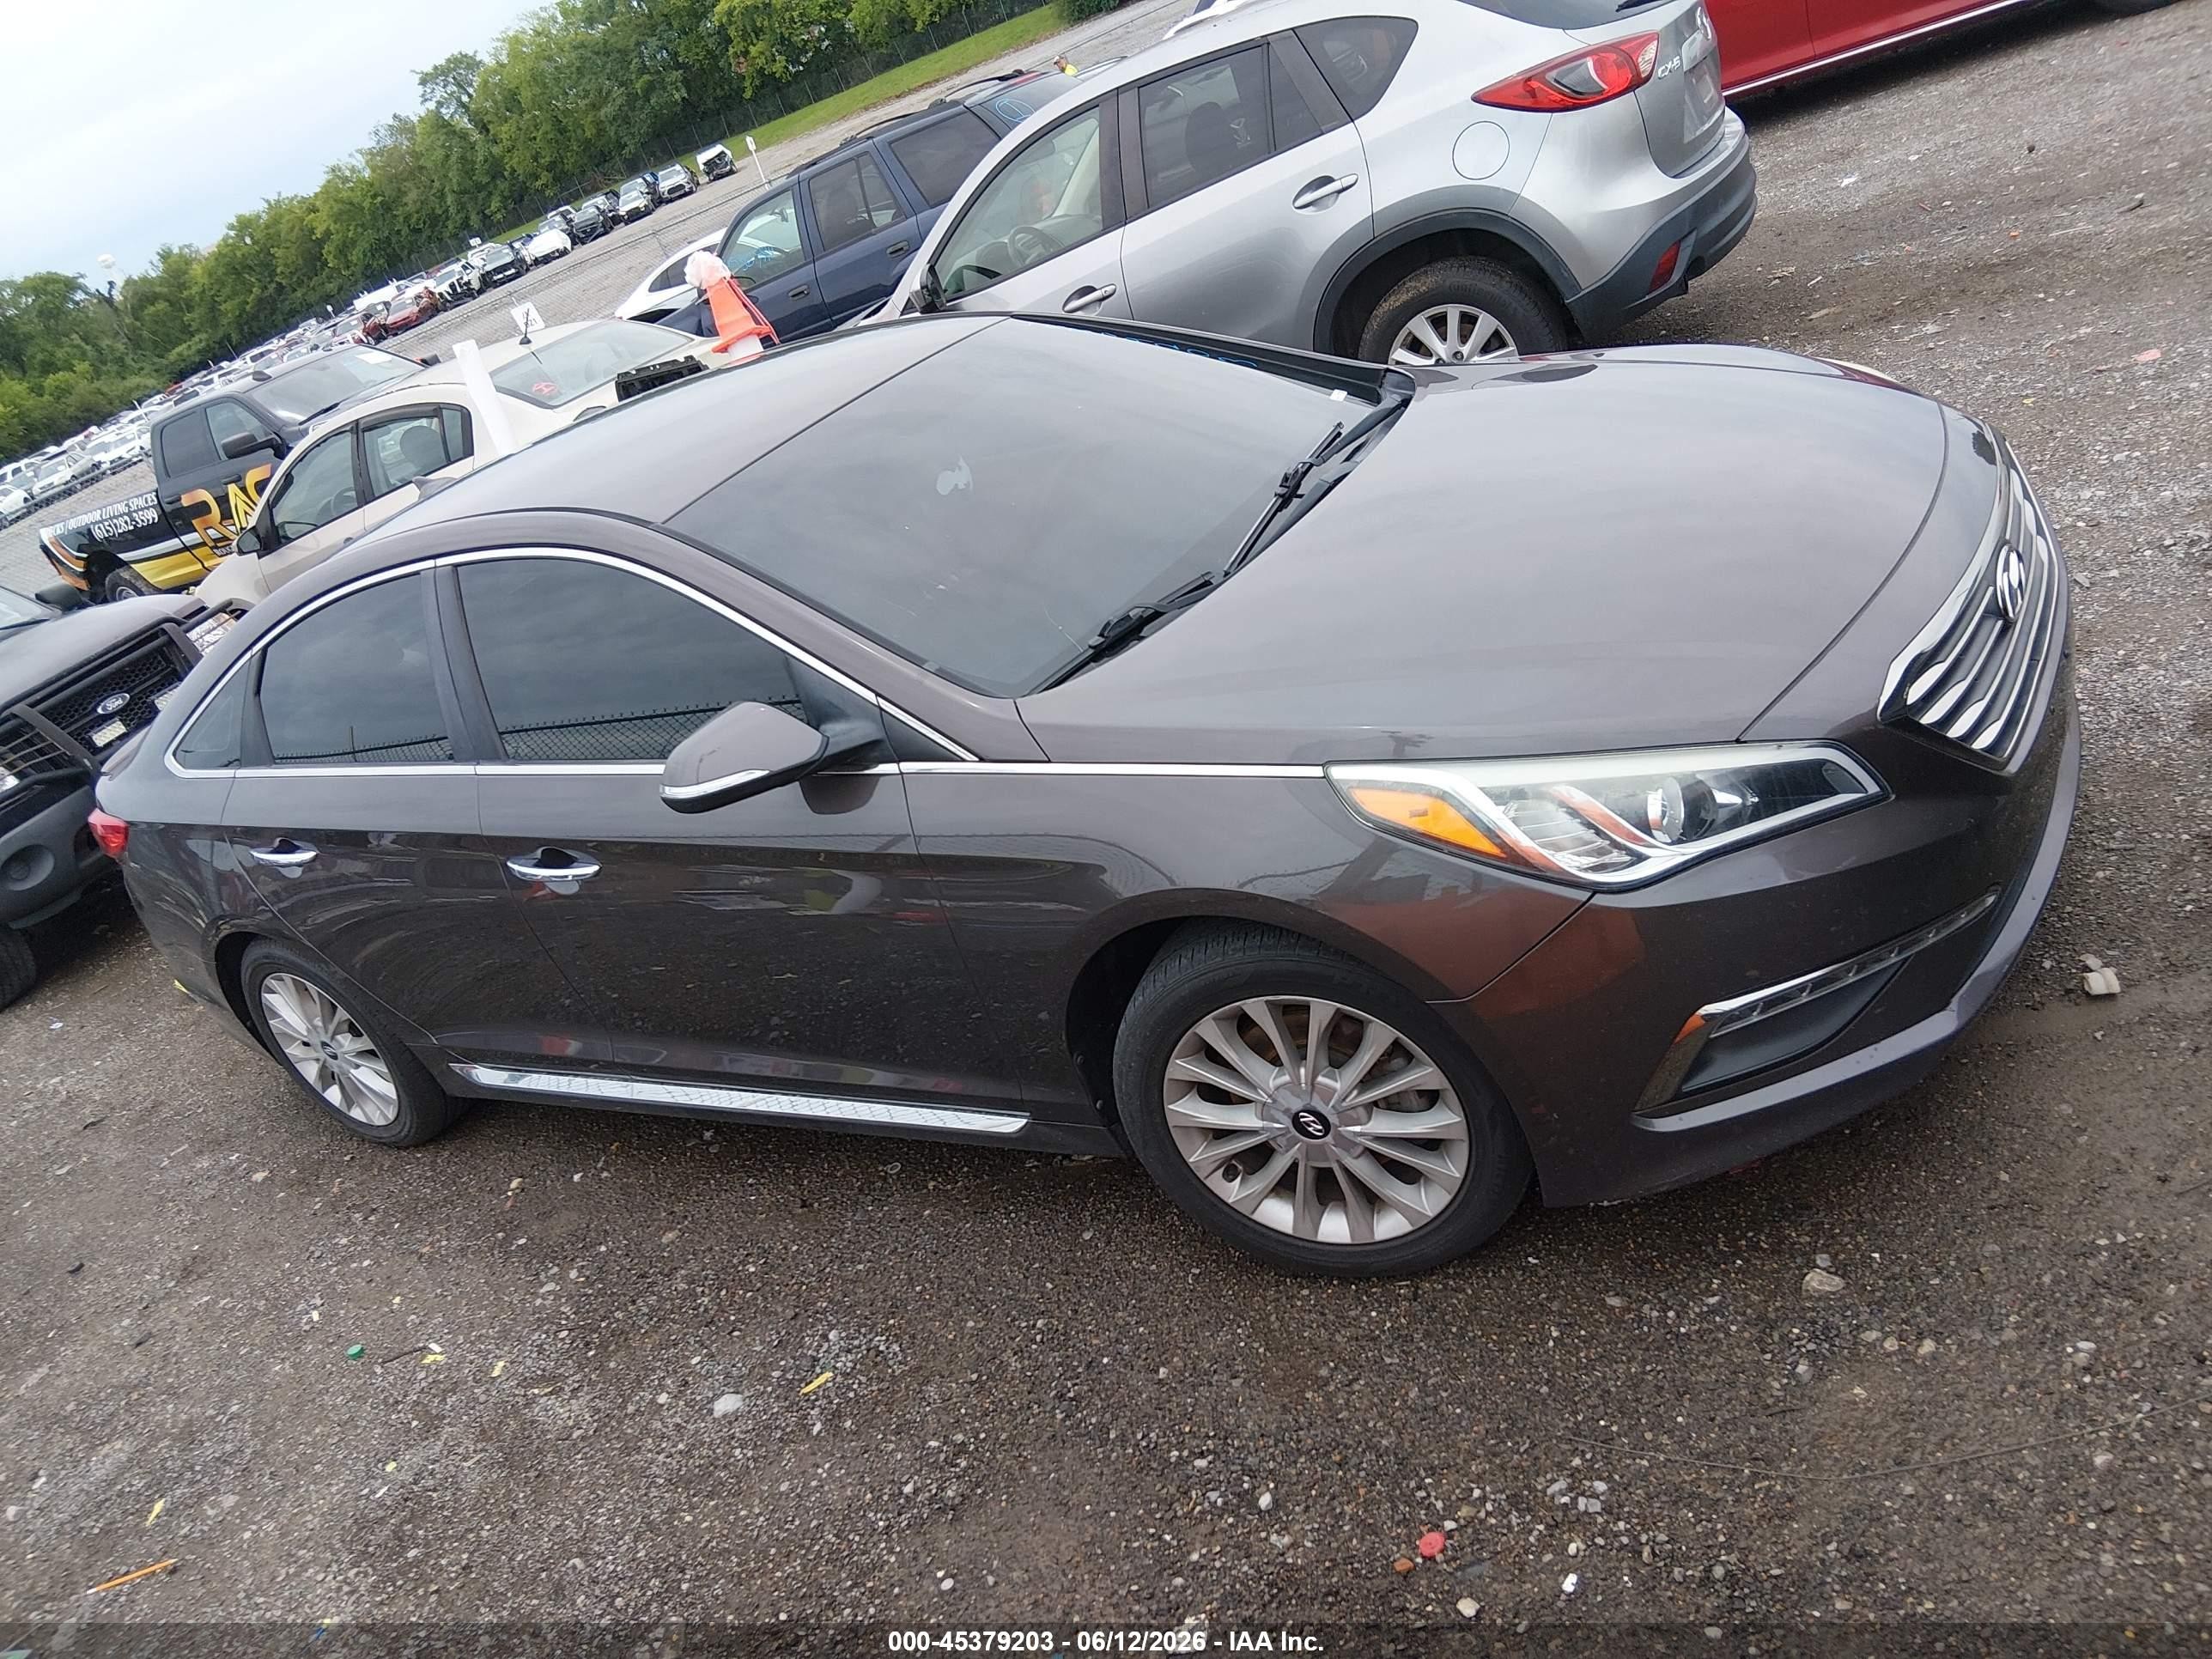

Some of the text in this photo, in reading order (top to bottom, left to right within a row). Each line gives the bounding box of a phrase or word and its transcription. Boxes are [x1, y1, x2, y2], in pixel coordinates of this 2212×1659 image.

[69, 509, 102, 530] OUTDOOR
[102, 501, 129, 520] LIVING
[129, 491, 158, 512] SPACES
[90, 507, 159, 543] (615)282-3599
